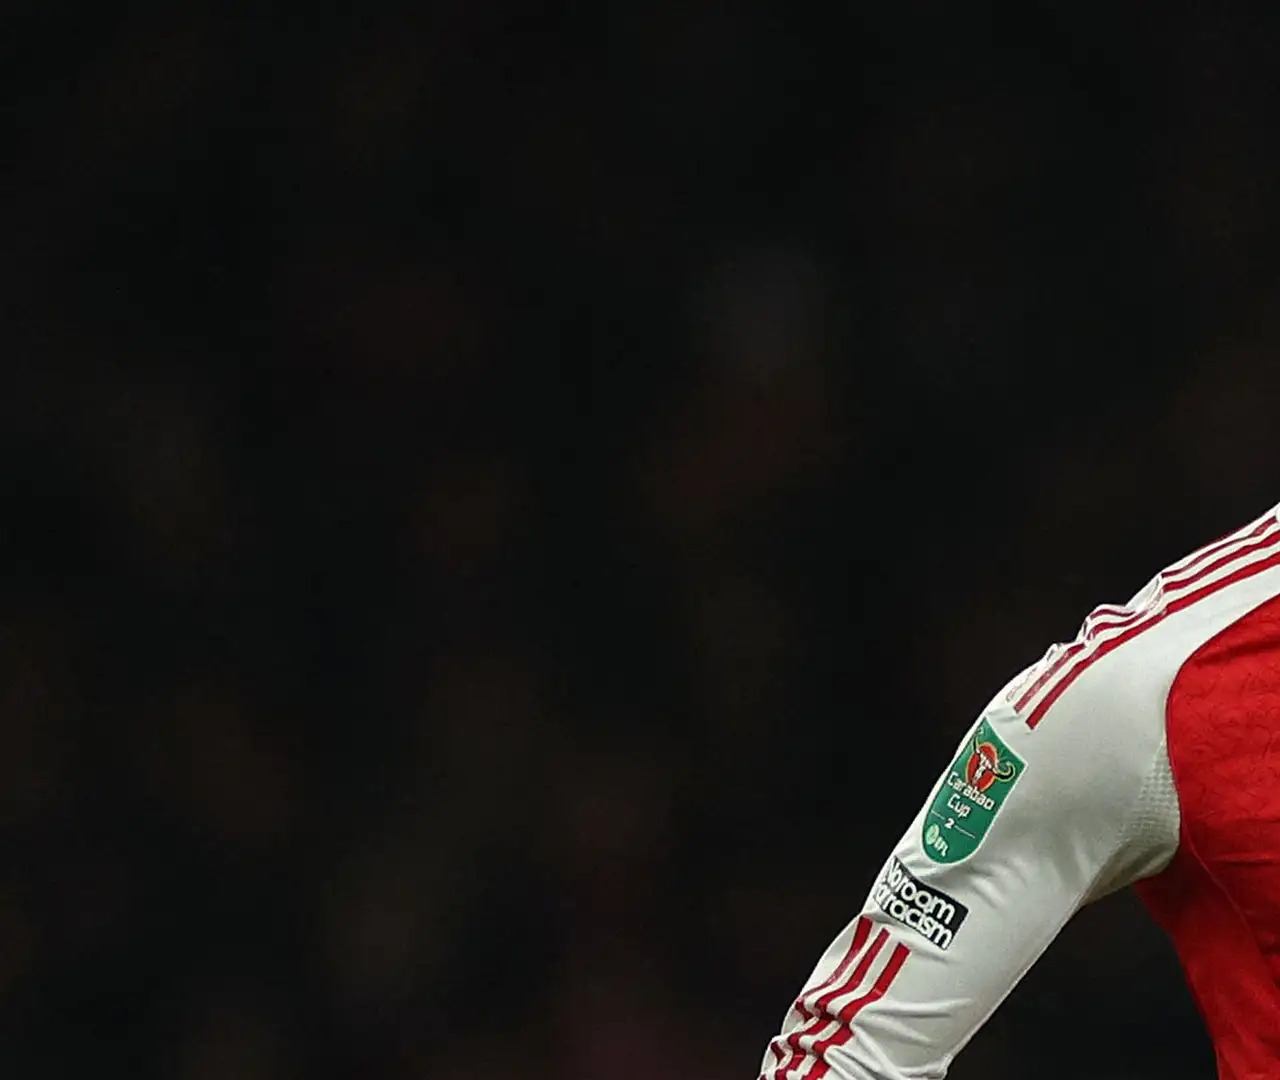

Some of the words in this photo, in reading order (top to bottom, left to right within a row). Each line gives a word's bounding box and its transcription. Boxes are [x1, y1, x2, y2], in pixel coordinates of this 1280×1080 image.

[947, 771, 995, 811] Carabao
[947, 793, 972, 819] Cup
[944, 817, 956, 830] 2
[894, 876, 956, 925] room
